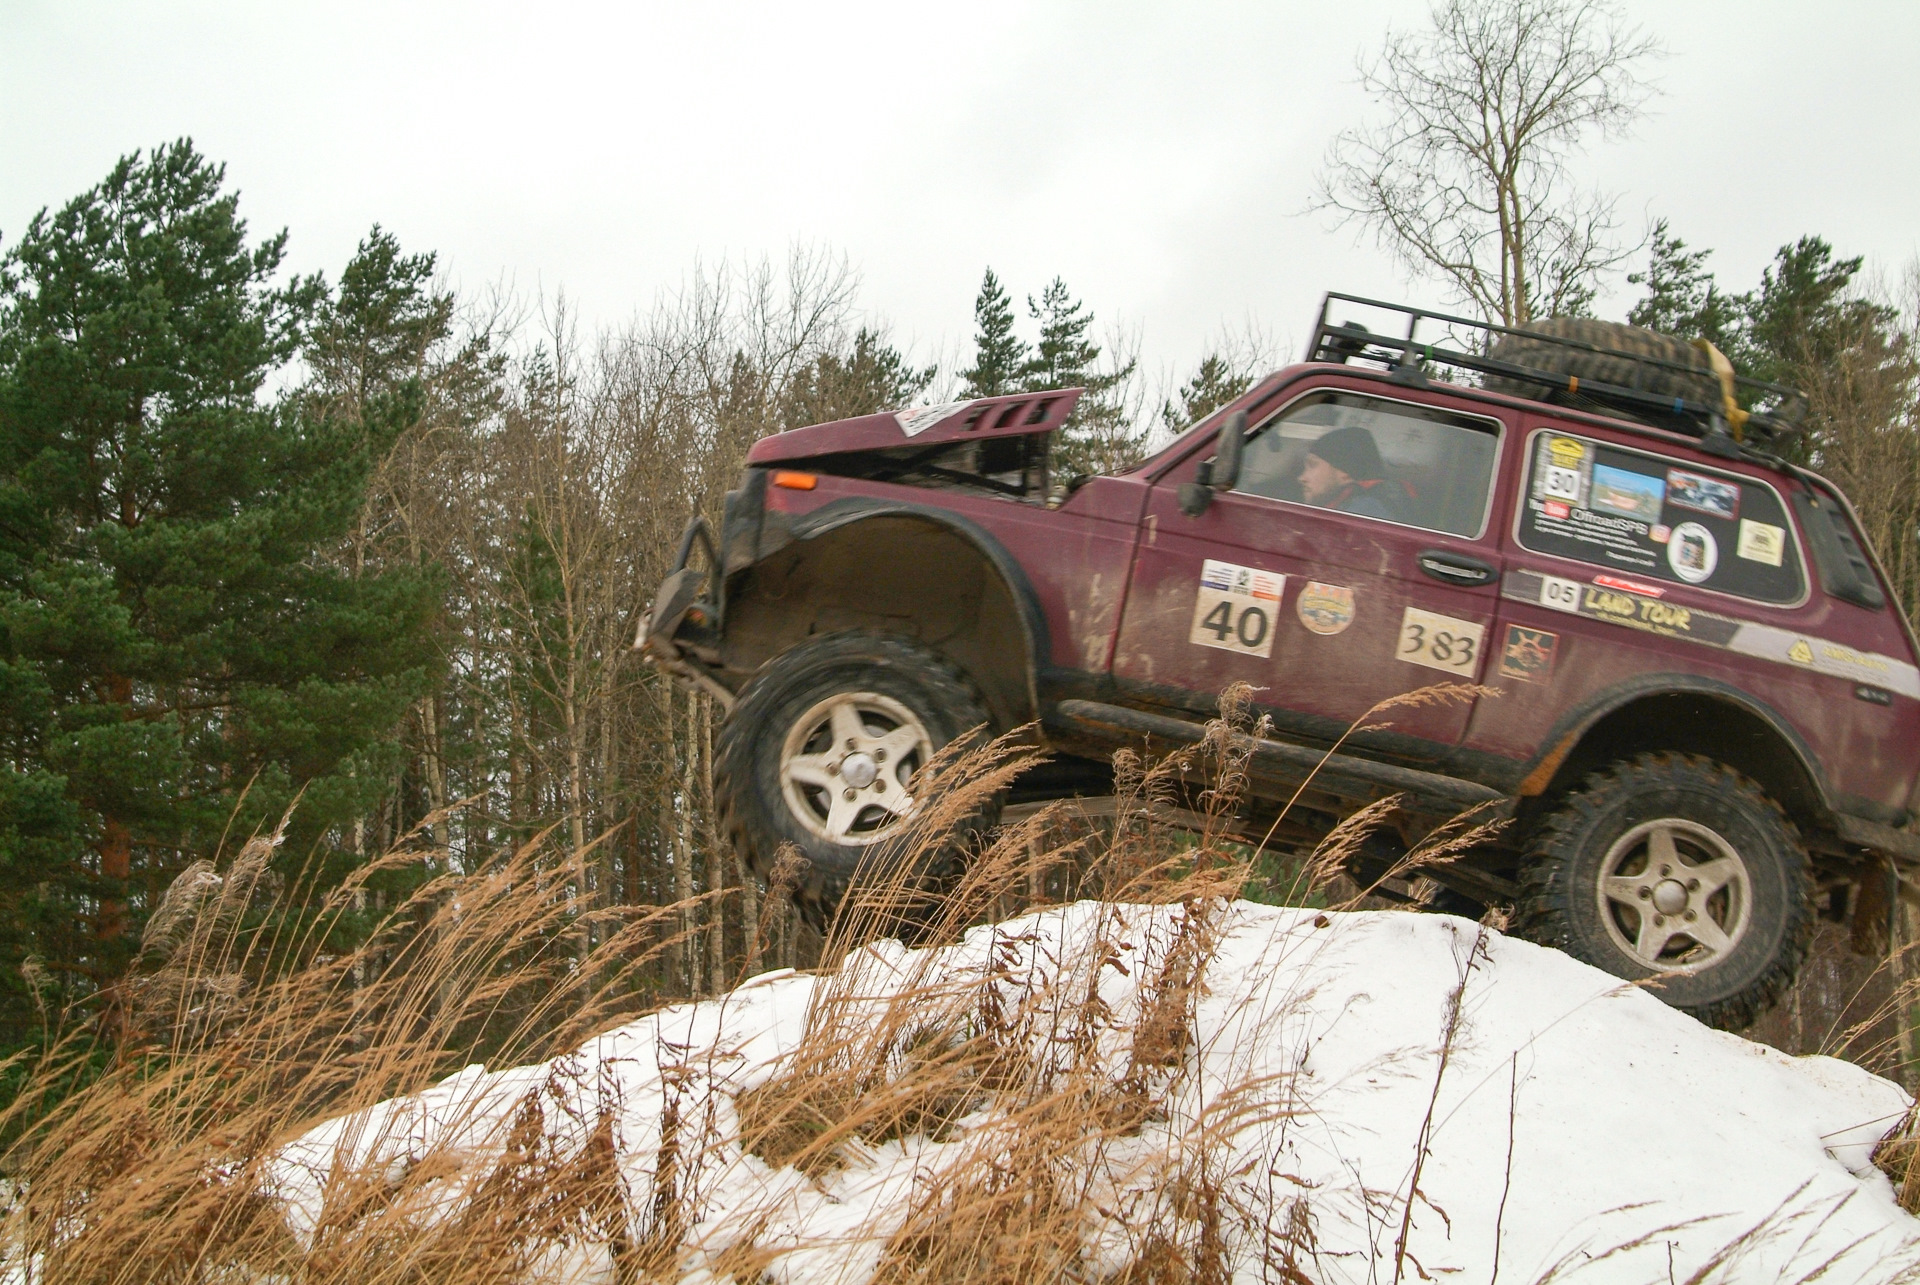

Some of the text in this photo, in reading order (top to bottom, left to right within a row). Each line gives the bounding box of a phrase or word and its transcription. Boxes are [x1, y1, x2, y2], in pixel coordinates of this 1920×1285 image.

[1551, 471, 1575, 493] 30
[1547, 582, 1574, 603] 05
[1584, 588, 1691, 631] LAND TOUR
[1201, 600, 1268, 648] 40
[1403, 624, 1475, 667] 383
